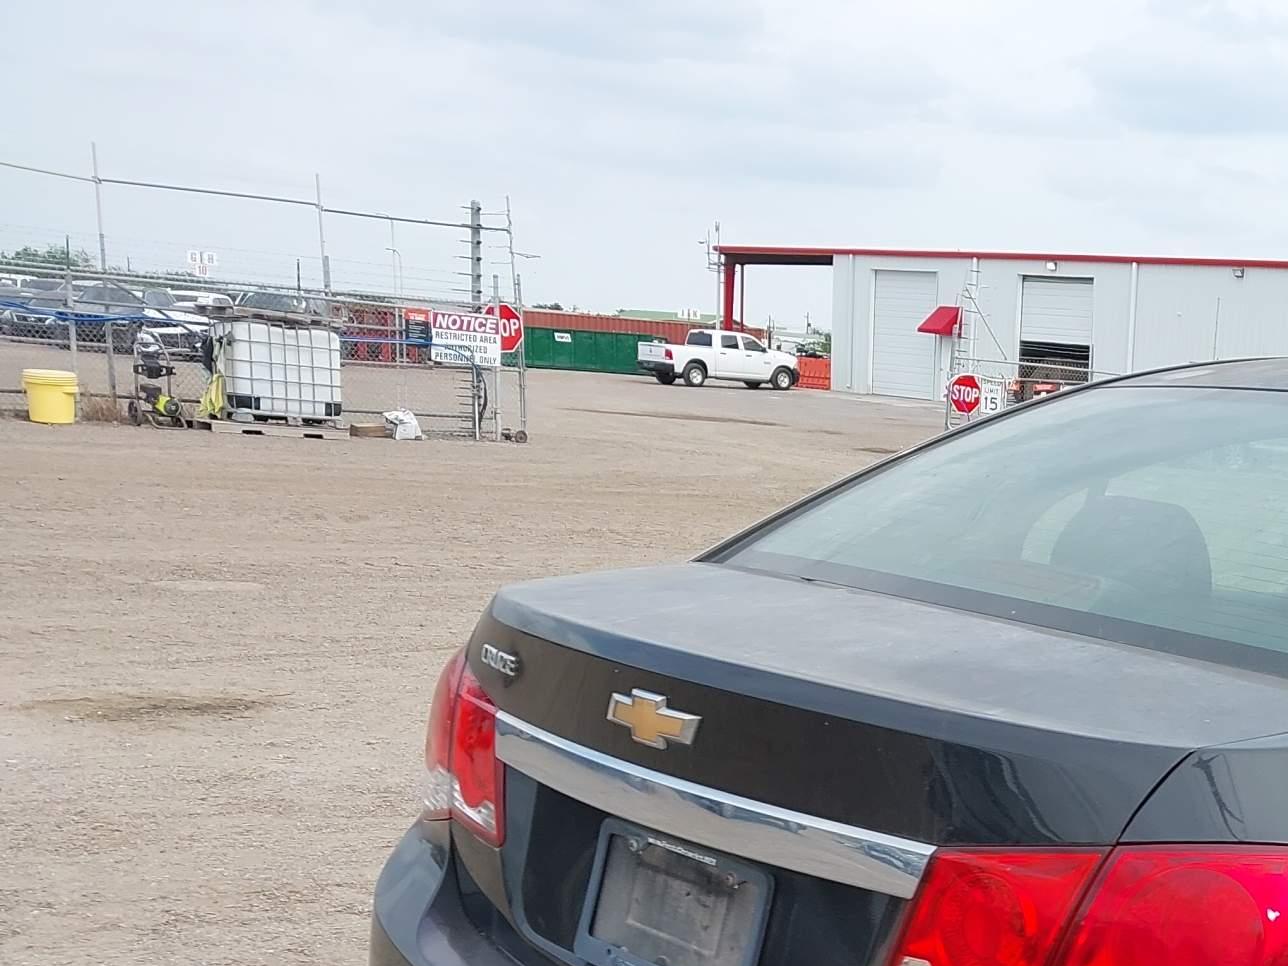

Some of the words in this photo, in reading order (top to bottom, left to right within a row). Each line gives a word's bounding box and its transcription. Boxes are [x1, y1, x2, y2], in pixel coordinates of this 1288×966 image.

[435, 314, 497, 333] NOTICE
[501, 318, 520, 337] OP
[435, 331, 478, 342] RESTRICTED
[479, 334, 498, 345] AREA
[479, 355, 498, 365] ONLY
[952, 384, 979, 403] STOP
[984, 396, 998, 411] 15
